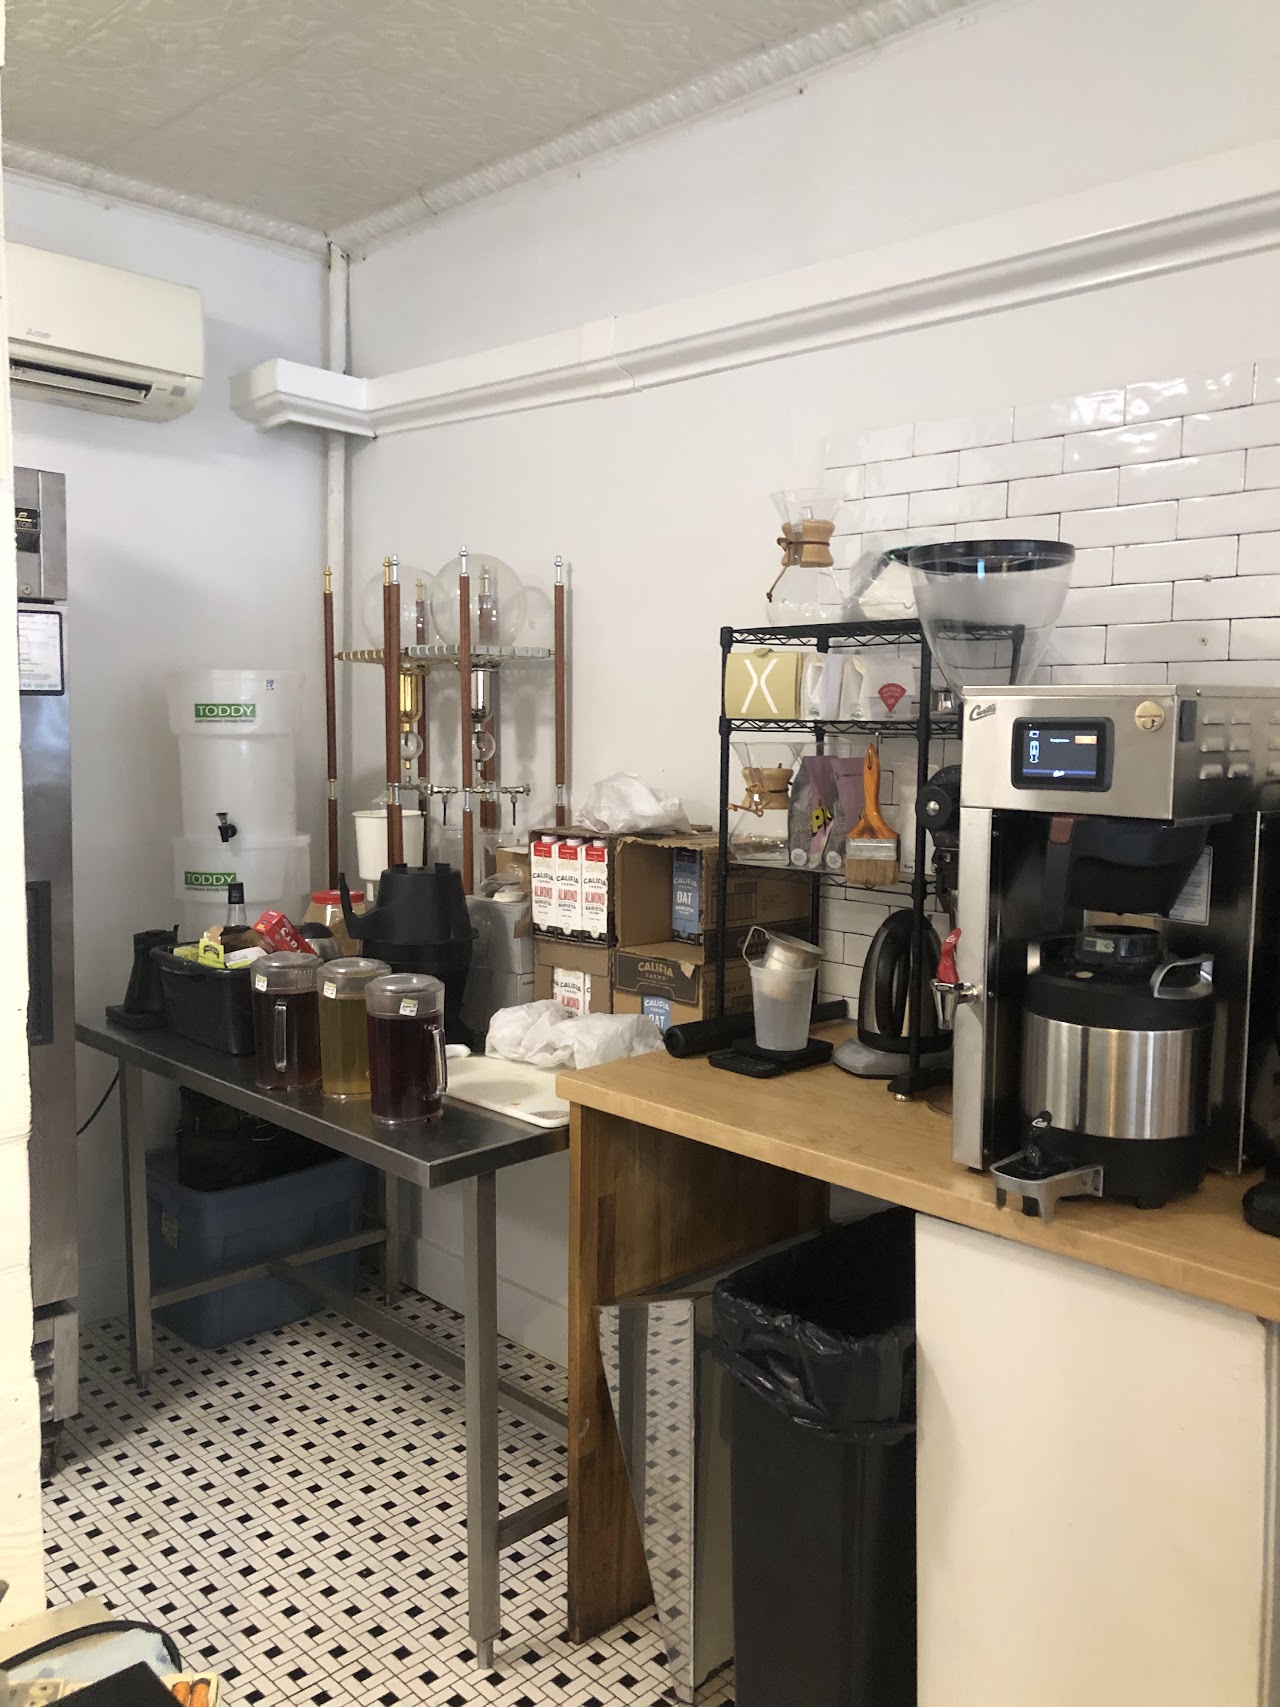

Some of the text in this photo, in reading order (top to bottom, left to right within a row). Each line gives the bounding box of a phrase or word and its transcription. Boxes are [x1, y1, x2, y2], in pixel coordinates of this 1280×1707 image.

[197, 705, 254, 716] TODDY
[186, 874, 234, 885] TODDY
[556, 875, 579, 884] CALIFIA
[583, 877, 607, 887] CALIFIA
[673, 877, 698, 887] CALIFIA
[676, 891, 693, 905] OAT
[637, 962, 674, 978] CALIFIA
[644, 1000, 670, 1011] CALIFIA
